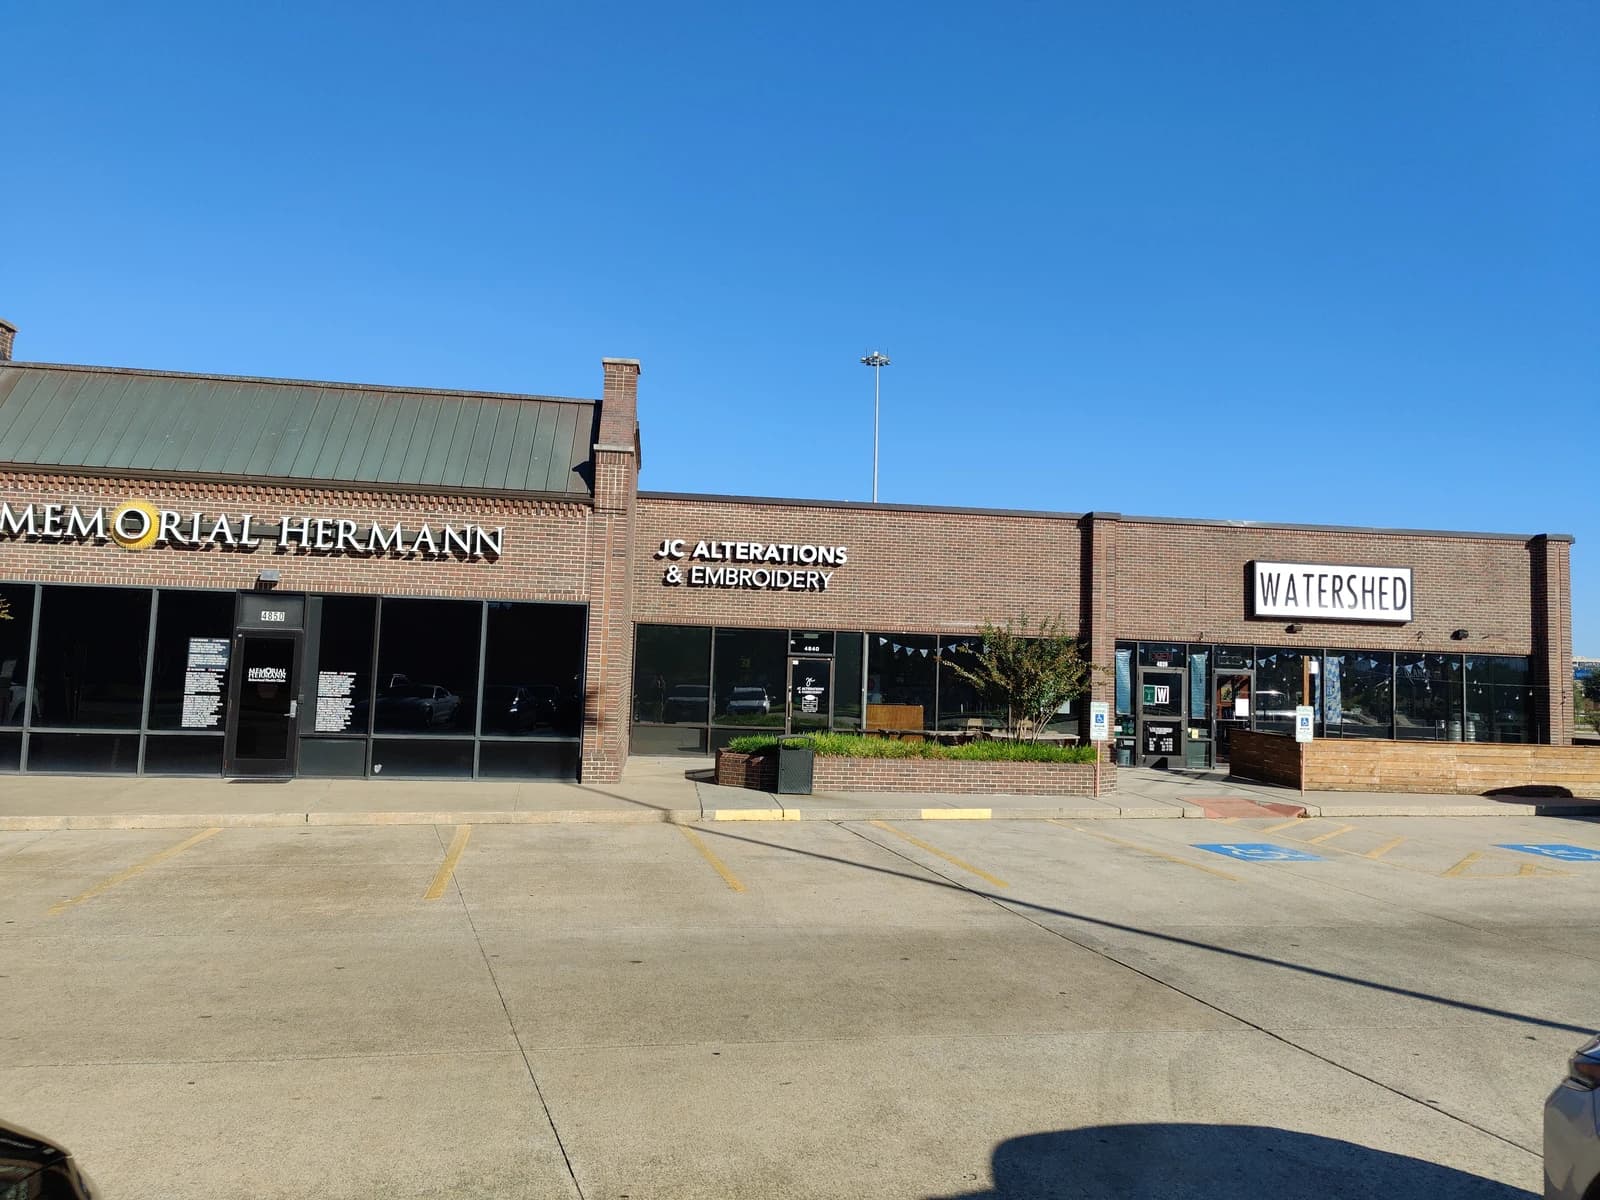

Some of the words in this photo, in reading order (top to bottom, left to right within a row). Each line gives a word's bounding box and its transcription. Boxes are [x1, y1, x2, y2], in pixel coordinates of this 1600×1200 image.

[0, 502, 260, 545] MEMORIAL
[278, 516, 505, 556] HERMANN
[657, 539, 686, 558] JC
[693, 541, 848, 564] ALTERATIONS
[666, 565, 682, 584] &
[691, 566, 834, 589] EMBROIDERY
[1260, 572, 1407, 611] WATERSHED
[261, 611, 285, 621] 4850
